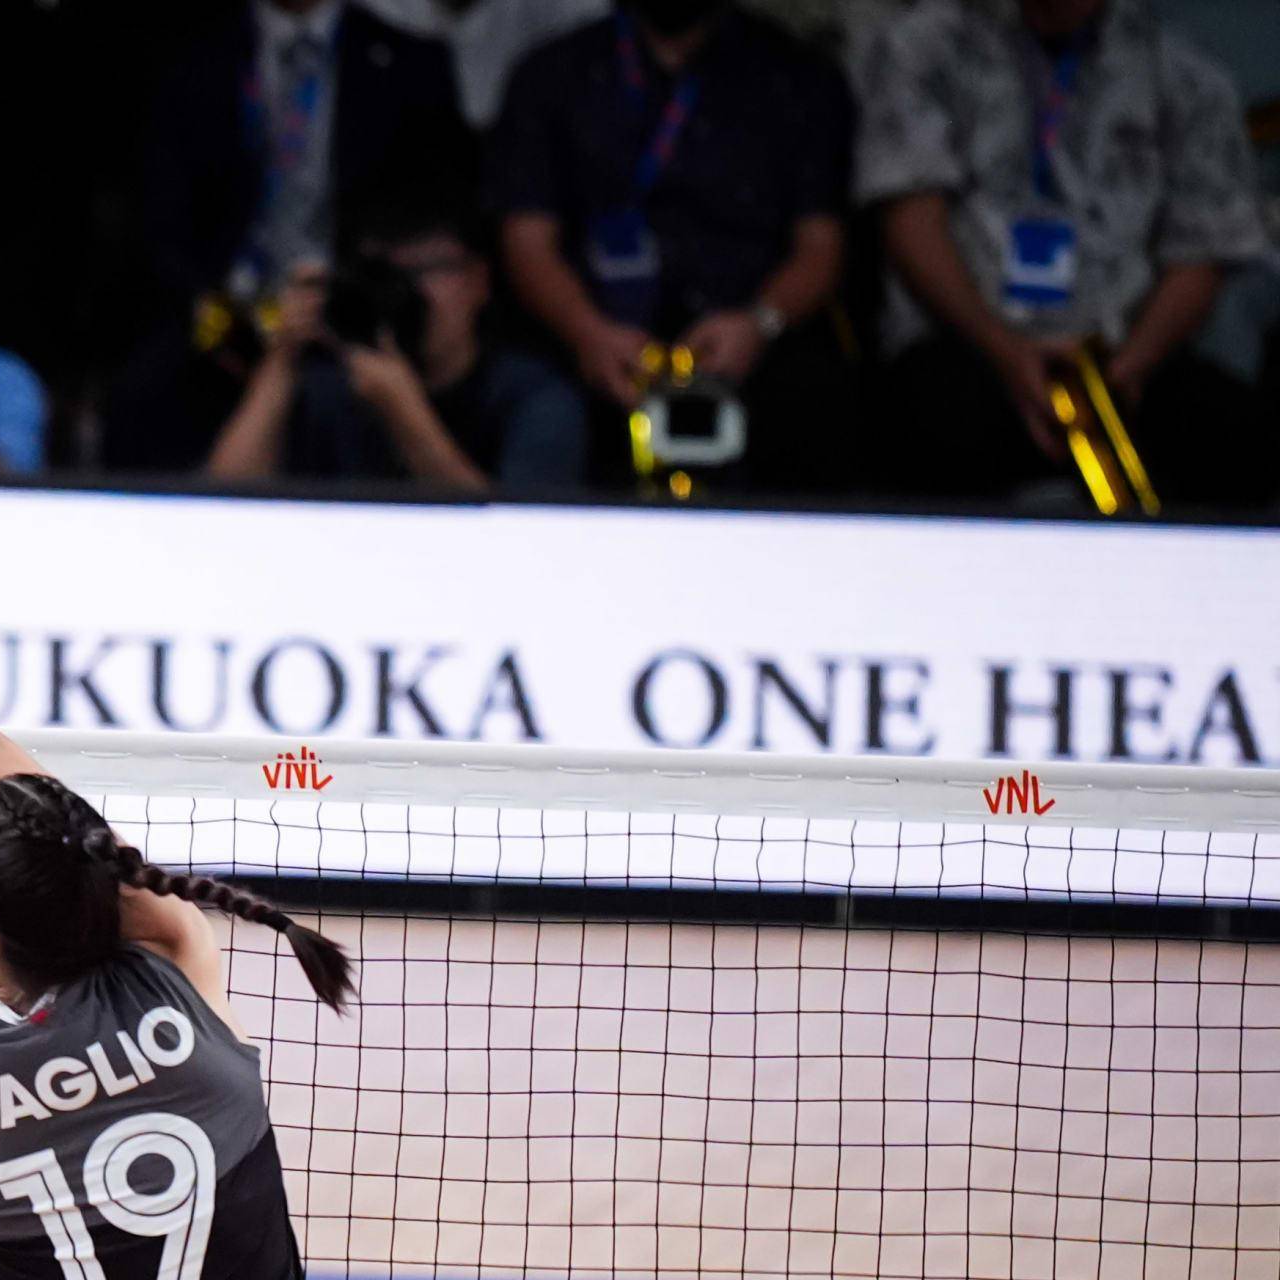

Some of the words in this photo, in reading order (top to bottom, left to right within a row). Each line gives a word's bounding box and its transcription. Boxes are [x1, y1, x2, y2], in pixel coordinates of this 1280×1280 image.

[630, 646, 936, 755] ONE
[263, 746, 333, 790] VNL
[983, 769, 1056, 815] VNL
